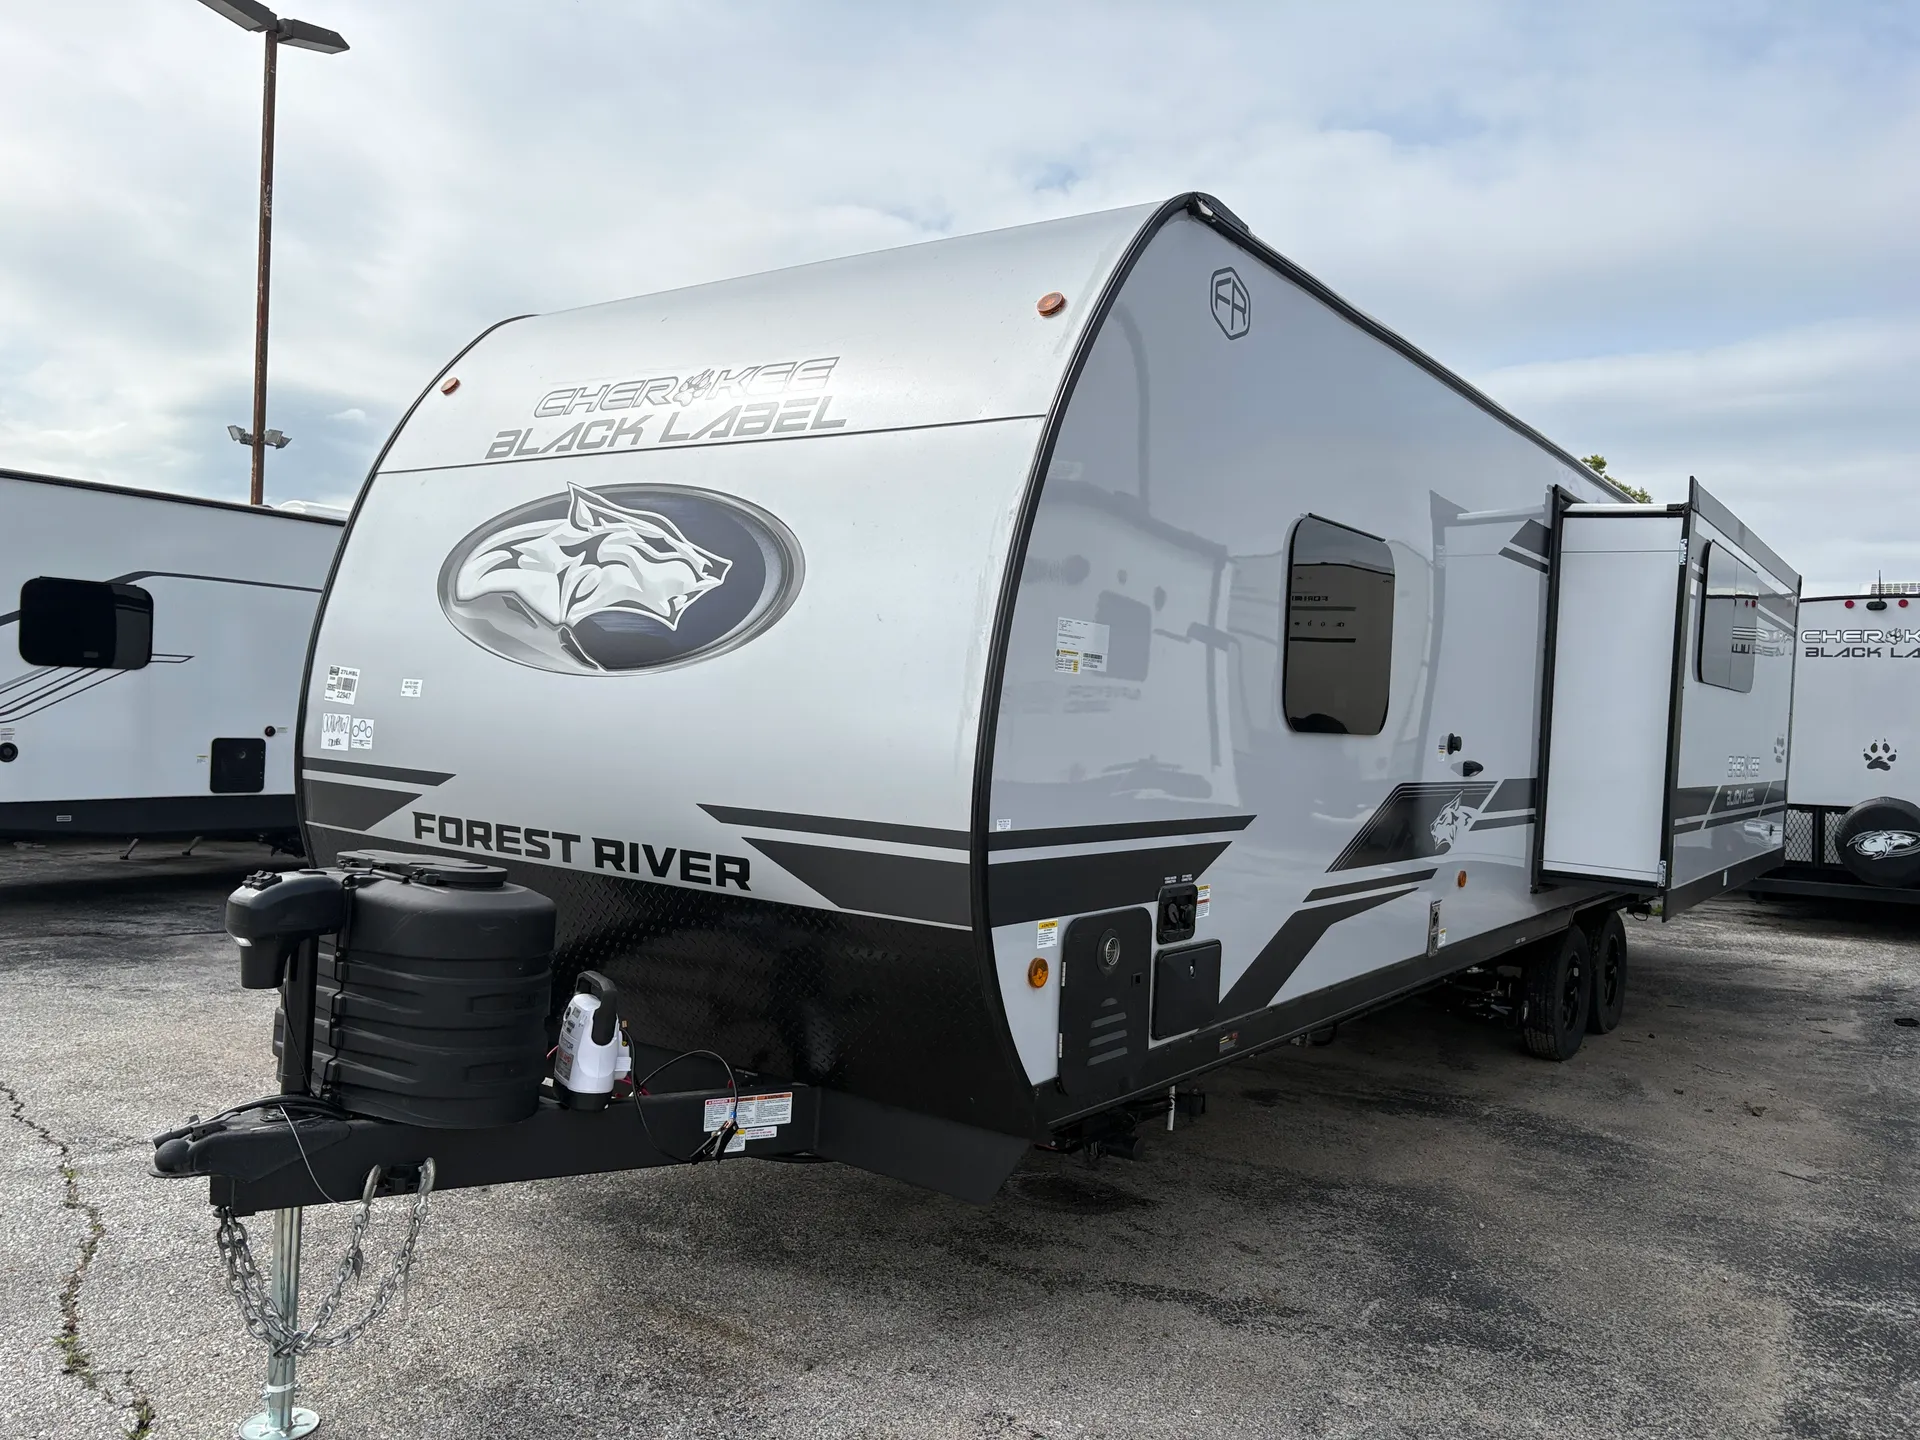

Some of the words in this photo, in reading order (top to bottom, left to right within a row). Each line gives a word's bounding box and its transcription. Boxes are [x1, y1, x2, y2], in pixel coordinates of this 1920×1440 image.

[485, 414, 654, 460] BLACK
[658, 395, 847, 443] LABEL
[1805, 647, 1883, 658] BLACK
[411, 810, 581, 863] FOREST
[591, 837, 752, 891] RIVER
